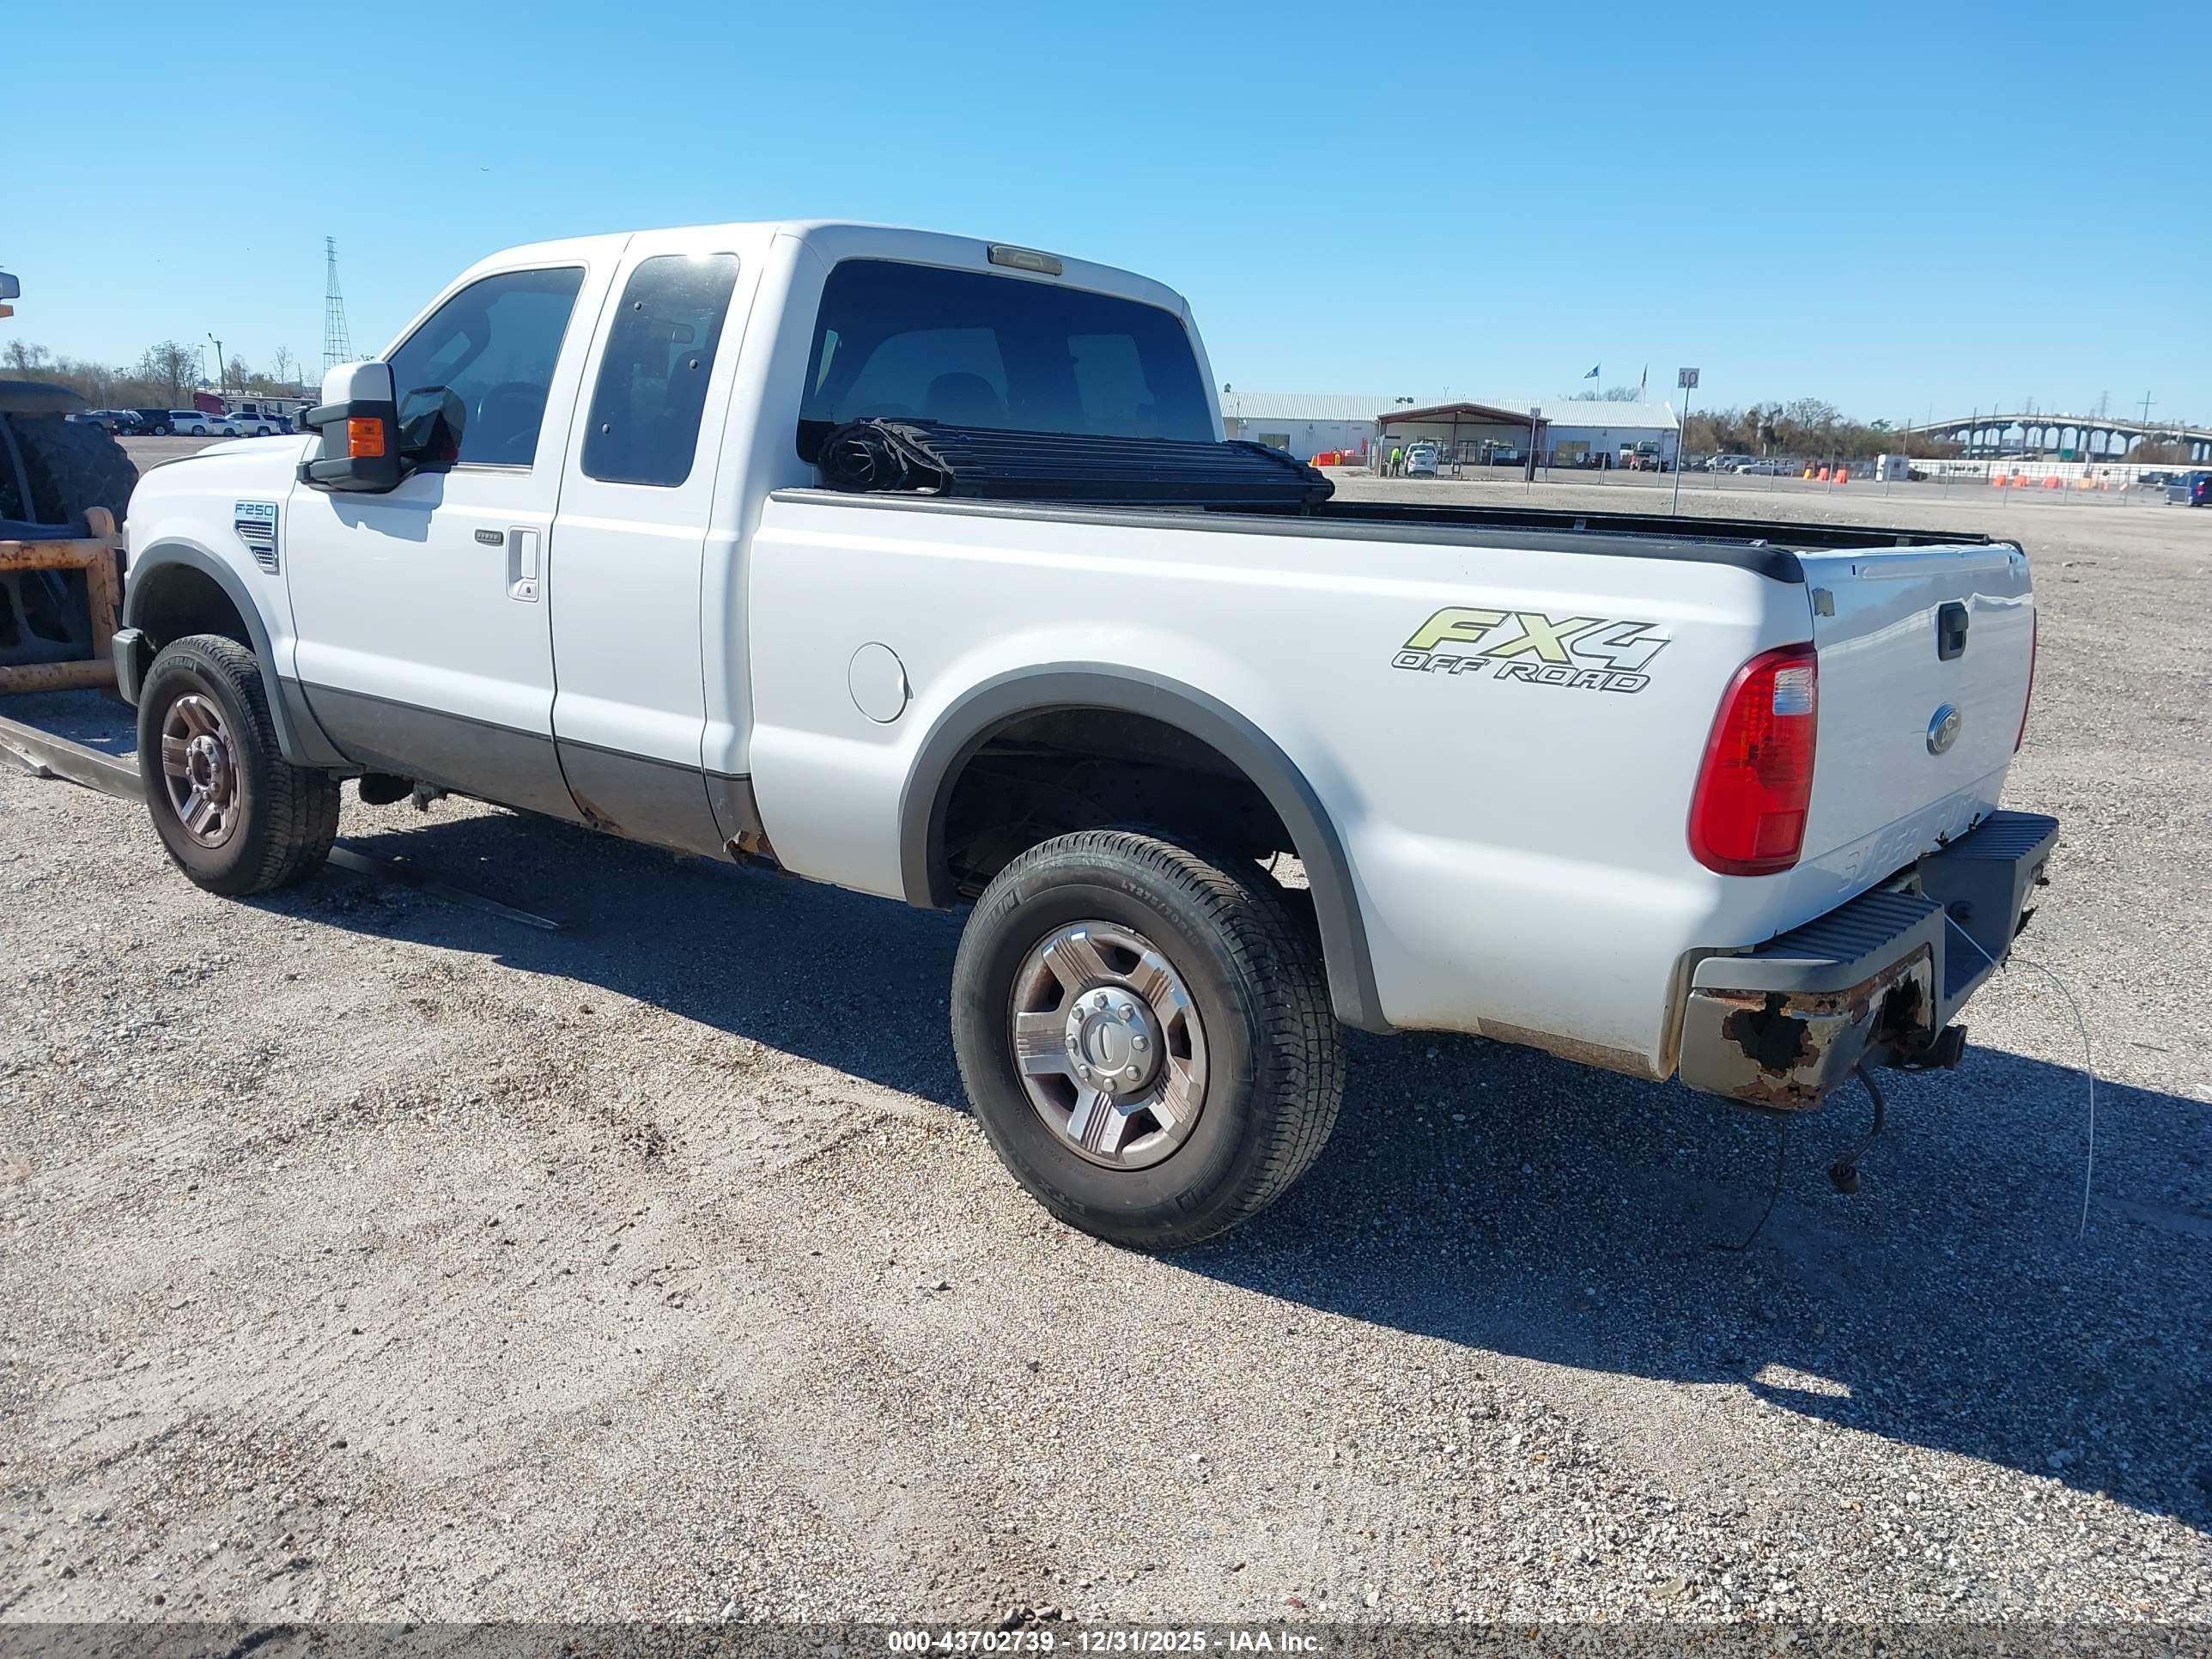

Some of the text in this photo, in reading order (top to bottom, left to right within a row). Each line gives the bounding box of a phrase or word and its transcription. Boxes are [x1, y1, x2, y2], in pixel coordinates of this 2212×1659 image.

[1679, 371, 1698, 385] 10
[1401, 605, 1671, 672] FX4
[1390, 650, 1651, 694] OFF ROAD
